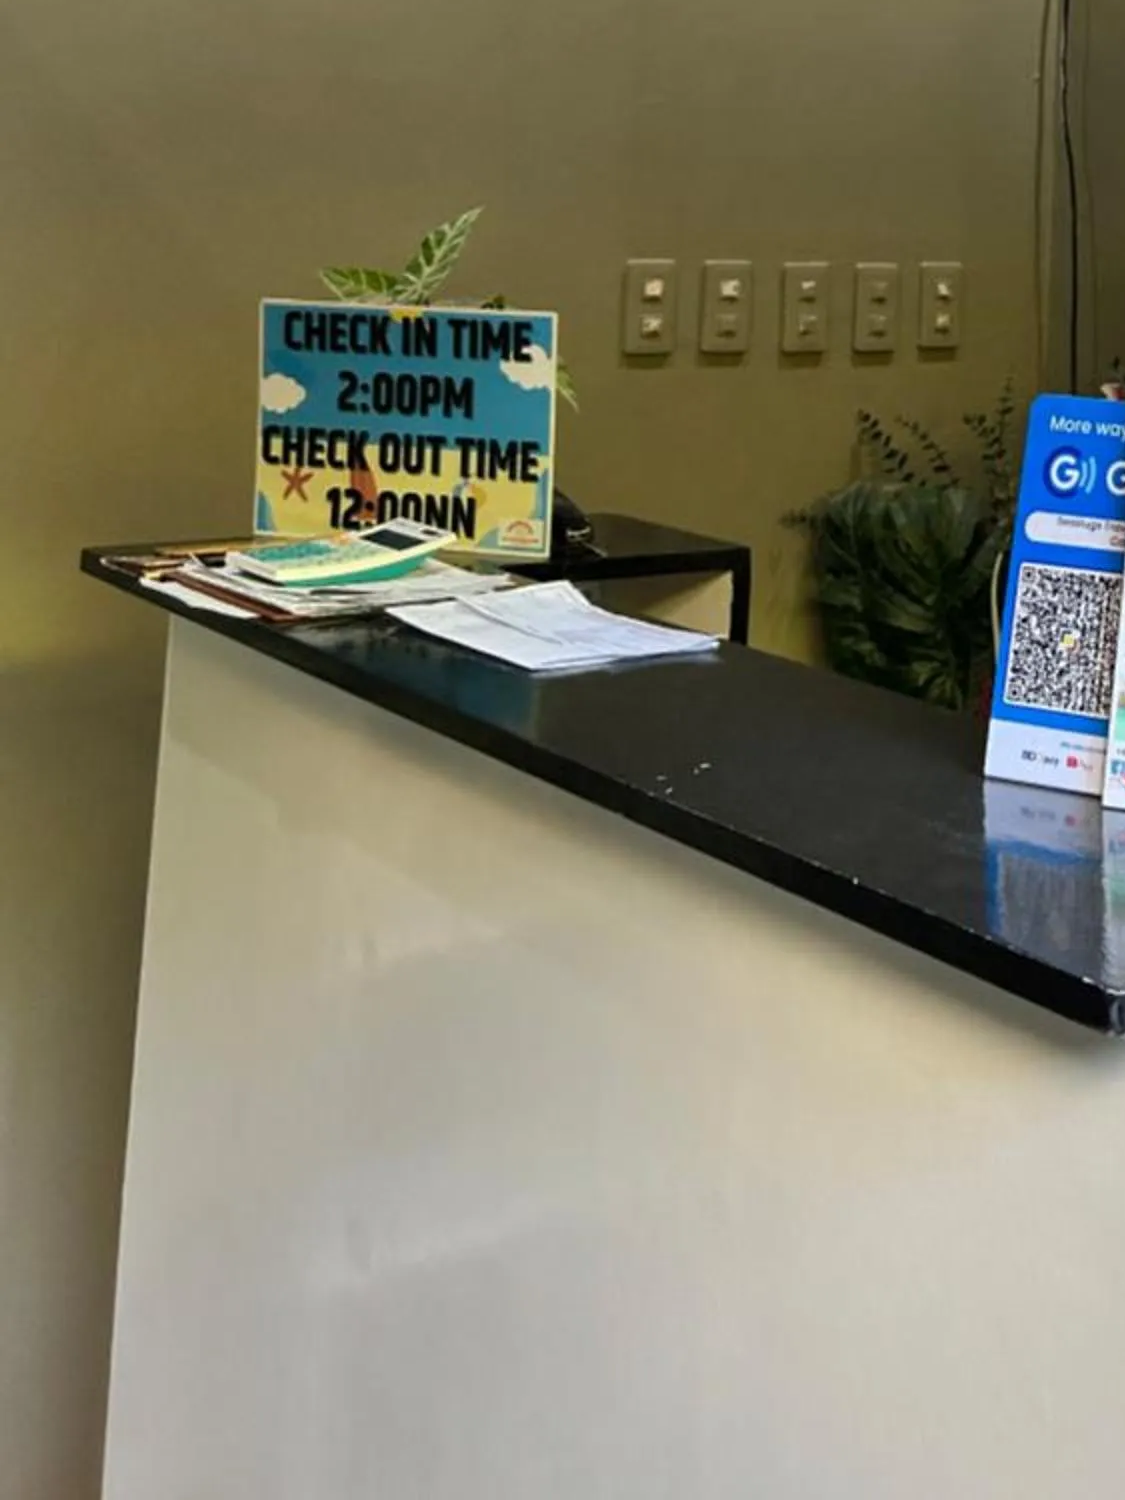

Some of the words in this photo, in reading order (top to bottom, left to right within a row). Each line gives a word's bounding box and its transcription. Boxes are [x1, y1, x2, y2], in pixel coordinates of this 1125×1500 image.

[284, 309, 392, 355] CHECK
[401, 315, 439, 358] IN
[448, 318, 534, 364] TIME
[336, 370, 475, 420] 2:00PM
[1049, 415, 1092, 435] More
[262, 424, 371, 471] CHECK
[378, 431, 448, 477] OUT
[454, 436, 541, 483] TIME
[326, 487, 477, 540] 12:00NN
